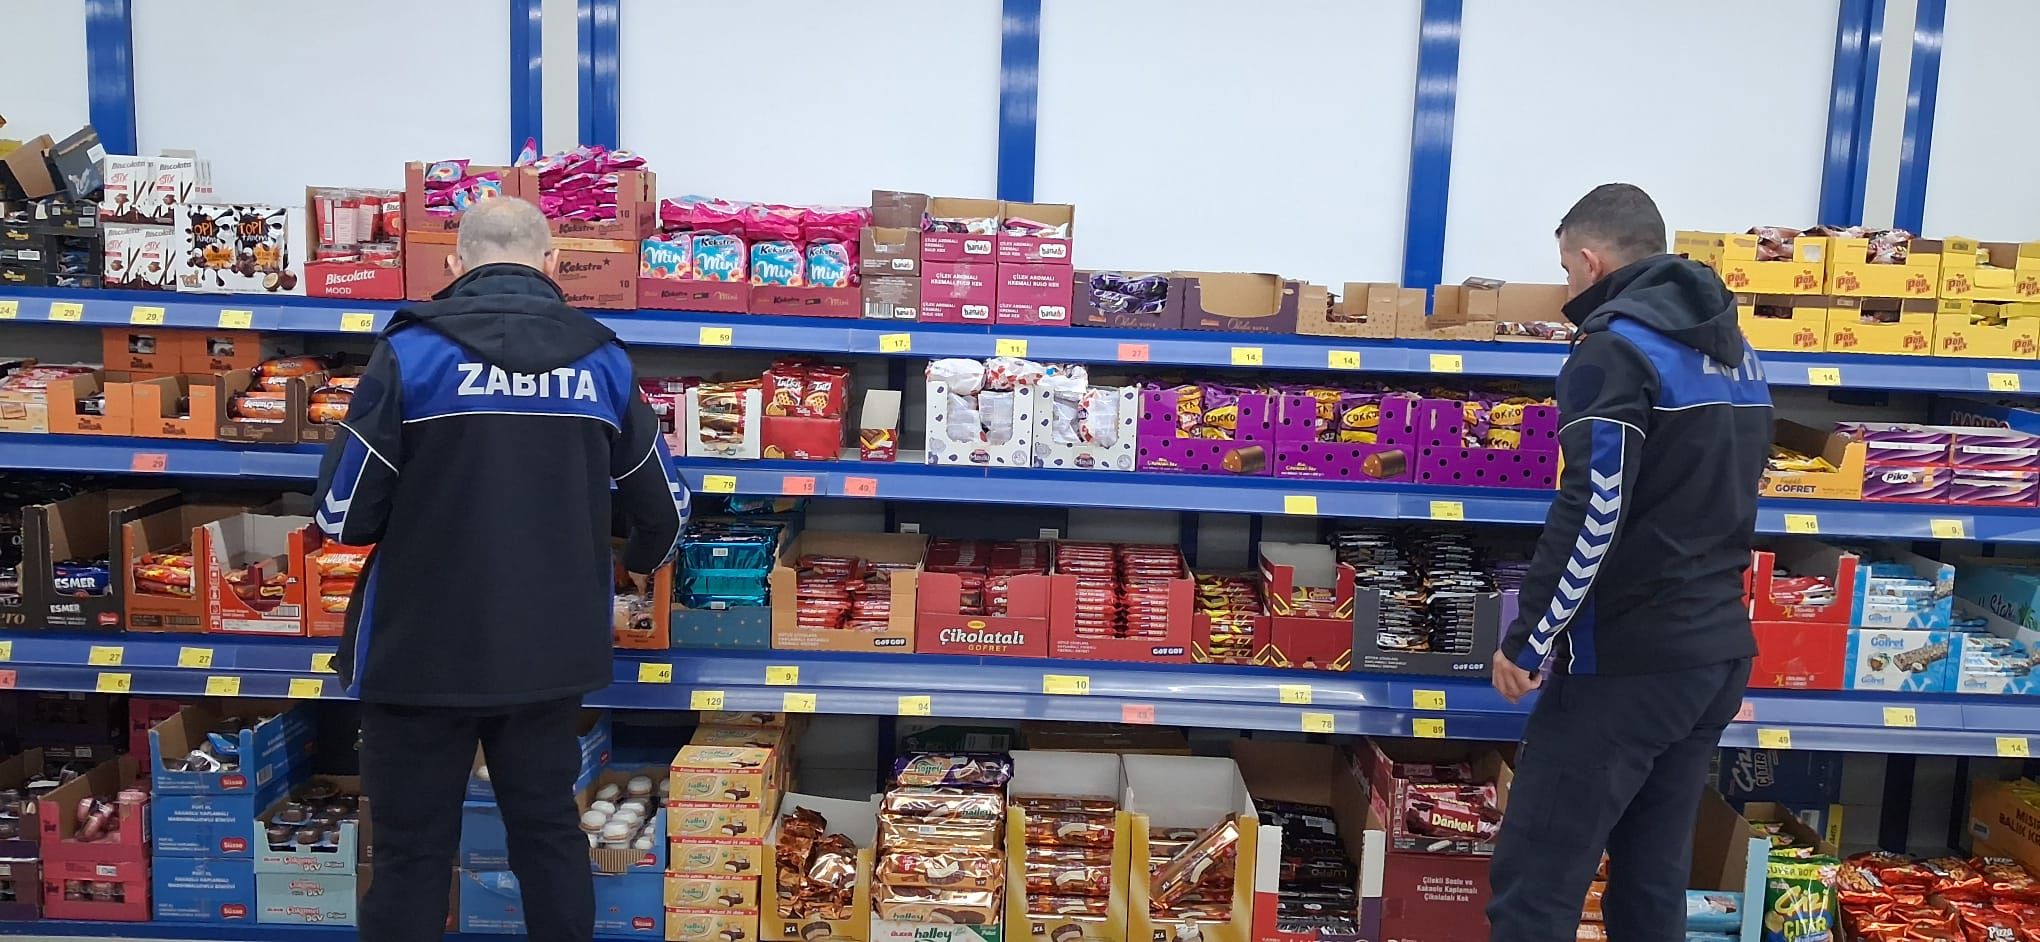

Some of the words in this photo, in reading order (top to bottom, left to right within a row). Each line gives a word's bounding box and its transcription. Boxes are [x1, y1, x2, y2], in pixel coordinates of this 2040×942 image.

[559, 261, 602, 274] Kekstra
[696, 253, 738, 270] Mini
[757, 261, 797, 278] Mini
[811, 264, 844, 279] Mini
[325, 270, 375, 285] Biscolata
[620, 280, 629, 288] 10
[1775, 484, 1816, 493] GOFRET
[54, 577, 96, 588] ESMER
[50, 604, 80, 613] ESMER
[939, 629, 1024, 645] Çikolatalı
[1871, 636, 1904, 649] Gofret
[706, 698, 721, 706] 129
[1432, 813, 1474, 832] Dankek
[915, 928, 952, 941] halley
